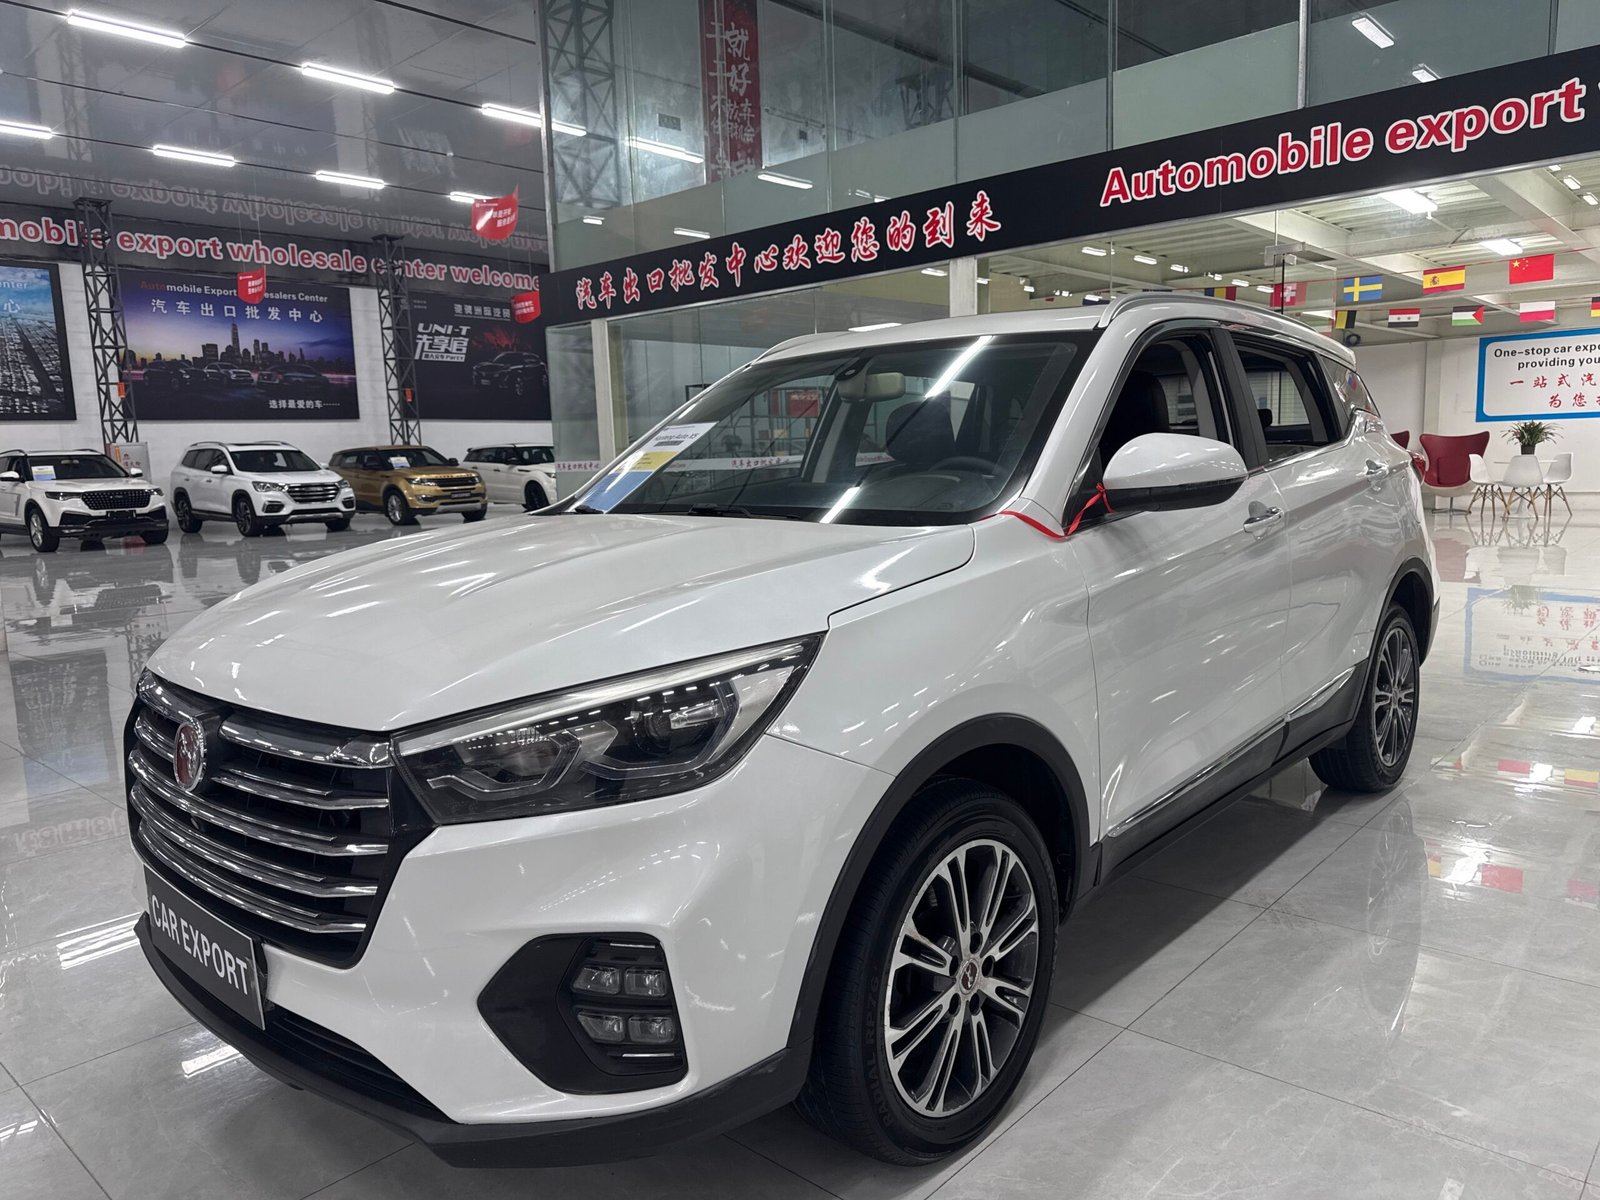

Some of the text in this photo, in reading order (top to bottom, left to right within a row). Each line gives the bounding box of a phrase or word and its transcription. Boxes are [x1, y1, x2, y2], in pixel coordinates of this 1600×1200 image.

[1100, 77, 1587, 207] Automobile export
[116, 231, 224, 260] export
[228, 239, 367, 274] wholesale
[576, 190, 1001, 310] 汽车出口批发中心欢迎您的到来
[140, 280, 202, 294] Automobile
[204, 285, 237, 297] Export
[264, 290, 297, 301] esalers
[298, 292, 328, 303] Center
[151, 298, 323, 323] 汽车出口批发中心
[417, 322, 471, 336] UNI-T
[1494, 348, 1550, 357] One-stop
[1553, 346, 1572, 354] car
[1518, 357, 1574, 370] providing
[152, 894, 248, 995] CAR EXPORT
